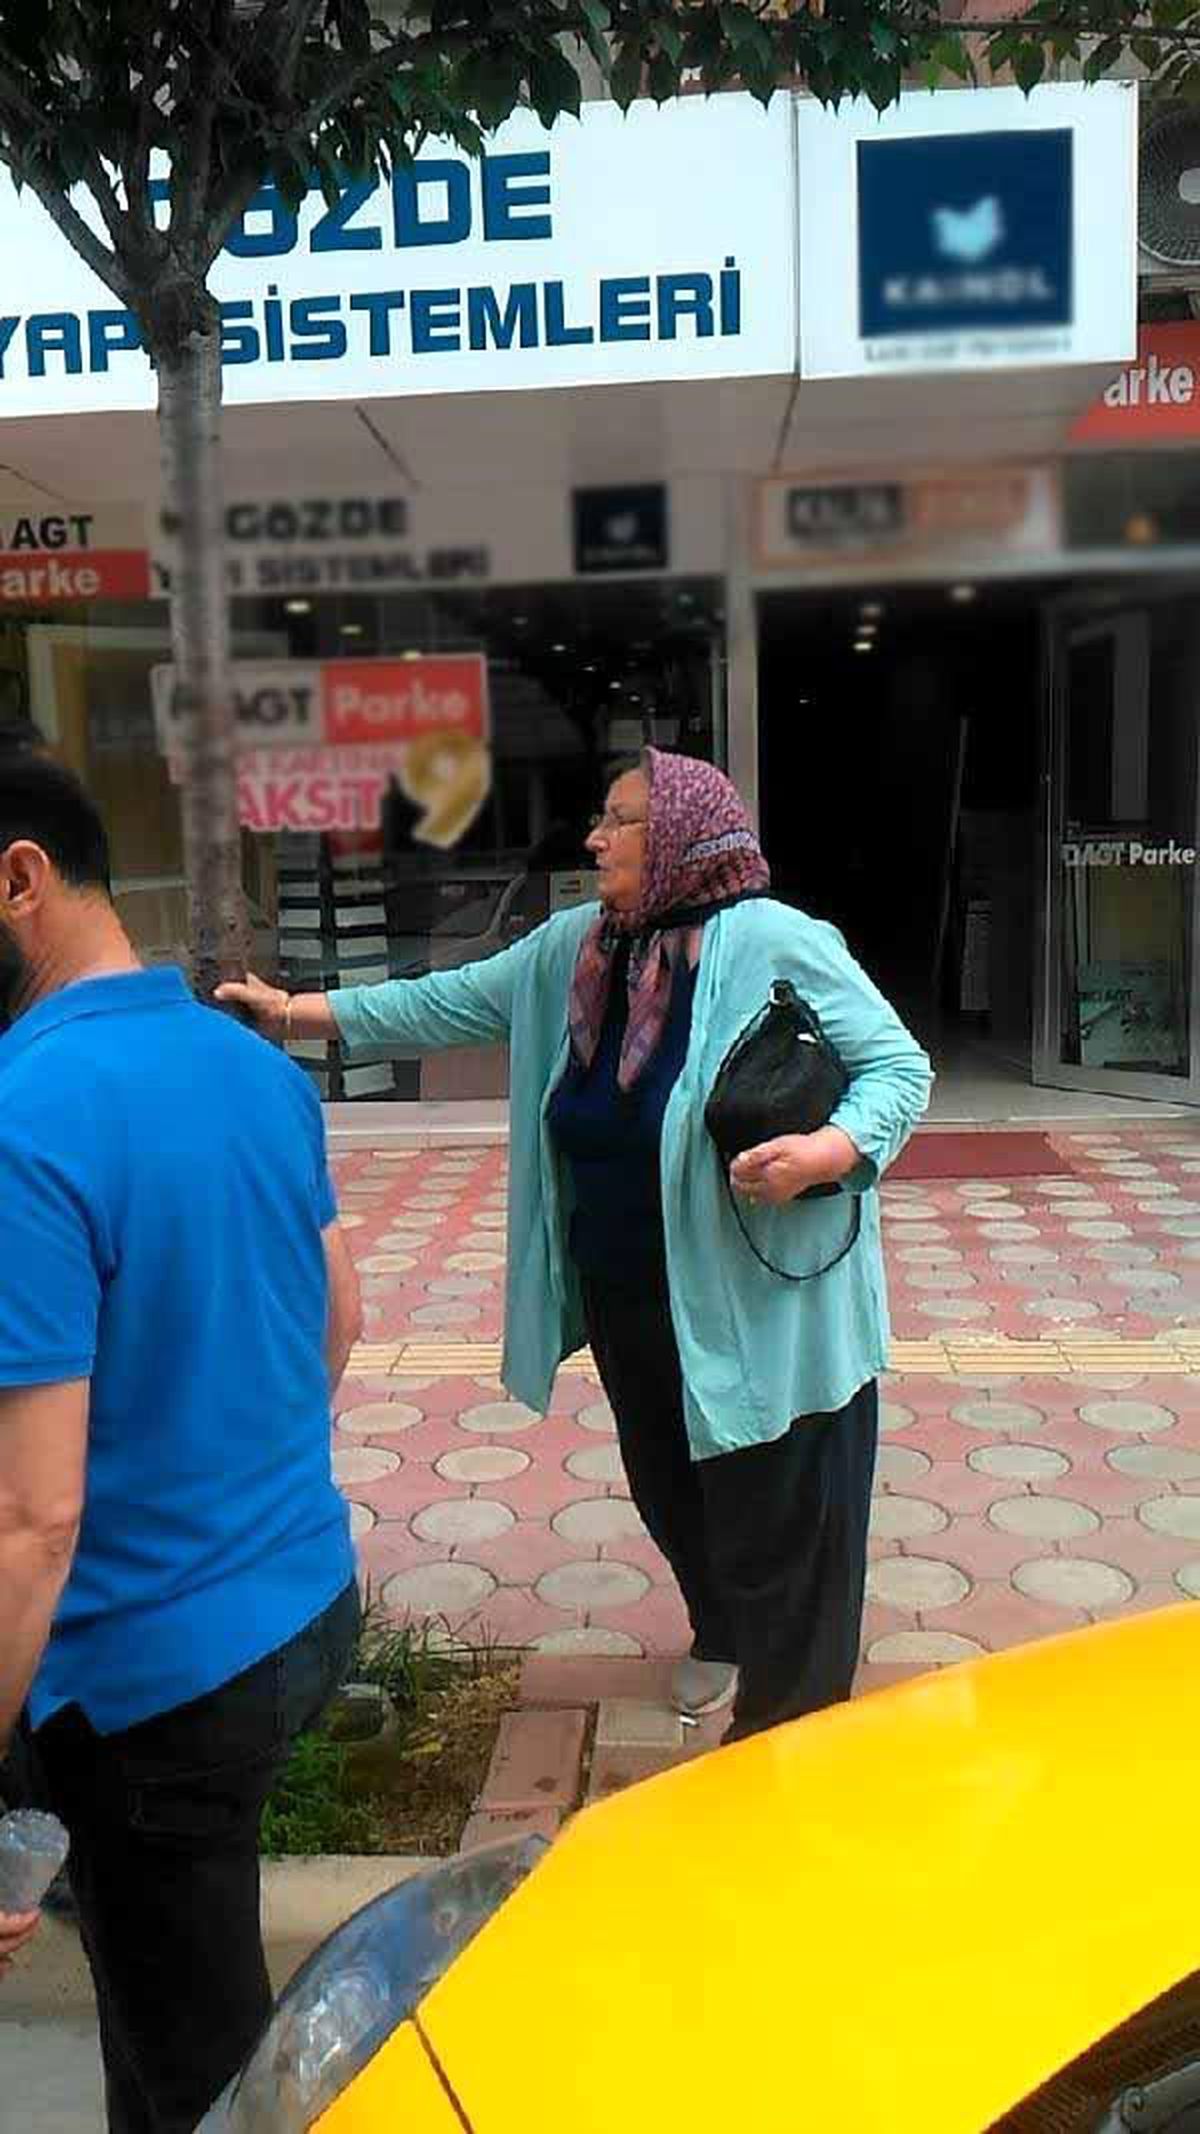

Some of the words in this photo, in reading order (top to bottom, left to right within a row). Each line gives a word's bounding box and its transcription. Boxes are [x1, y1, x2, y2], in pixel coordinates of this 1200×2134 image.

[146, 151, 552, 258] ÖZDE
[220, 256, 741, 365] SİSTEMLERİ
[11, 514, 93, 550] AGT
[335, 678, 469, 724] Parke
[238, 776, 383, 828] AKSİT
[1129, 839, 1196, 865] Parke
